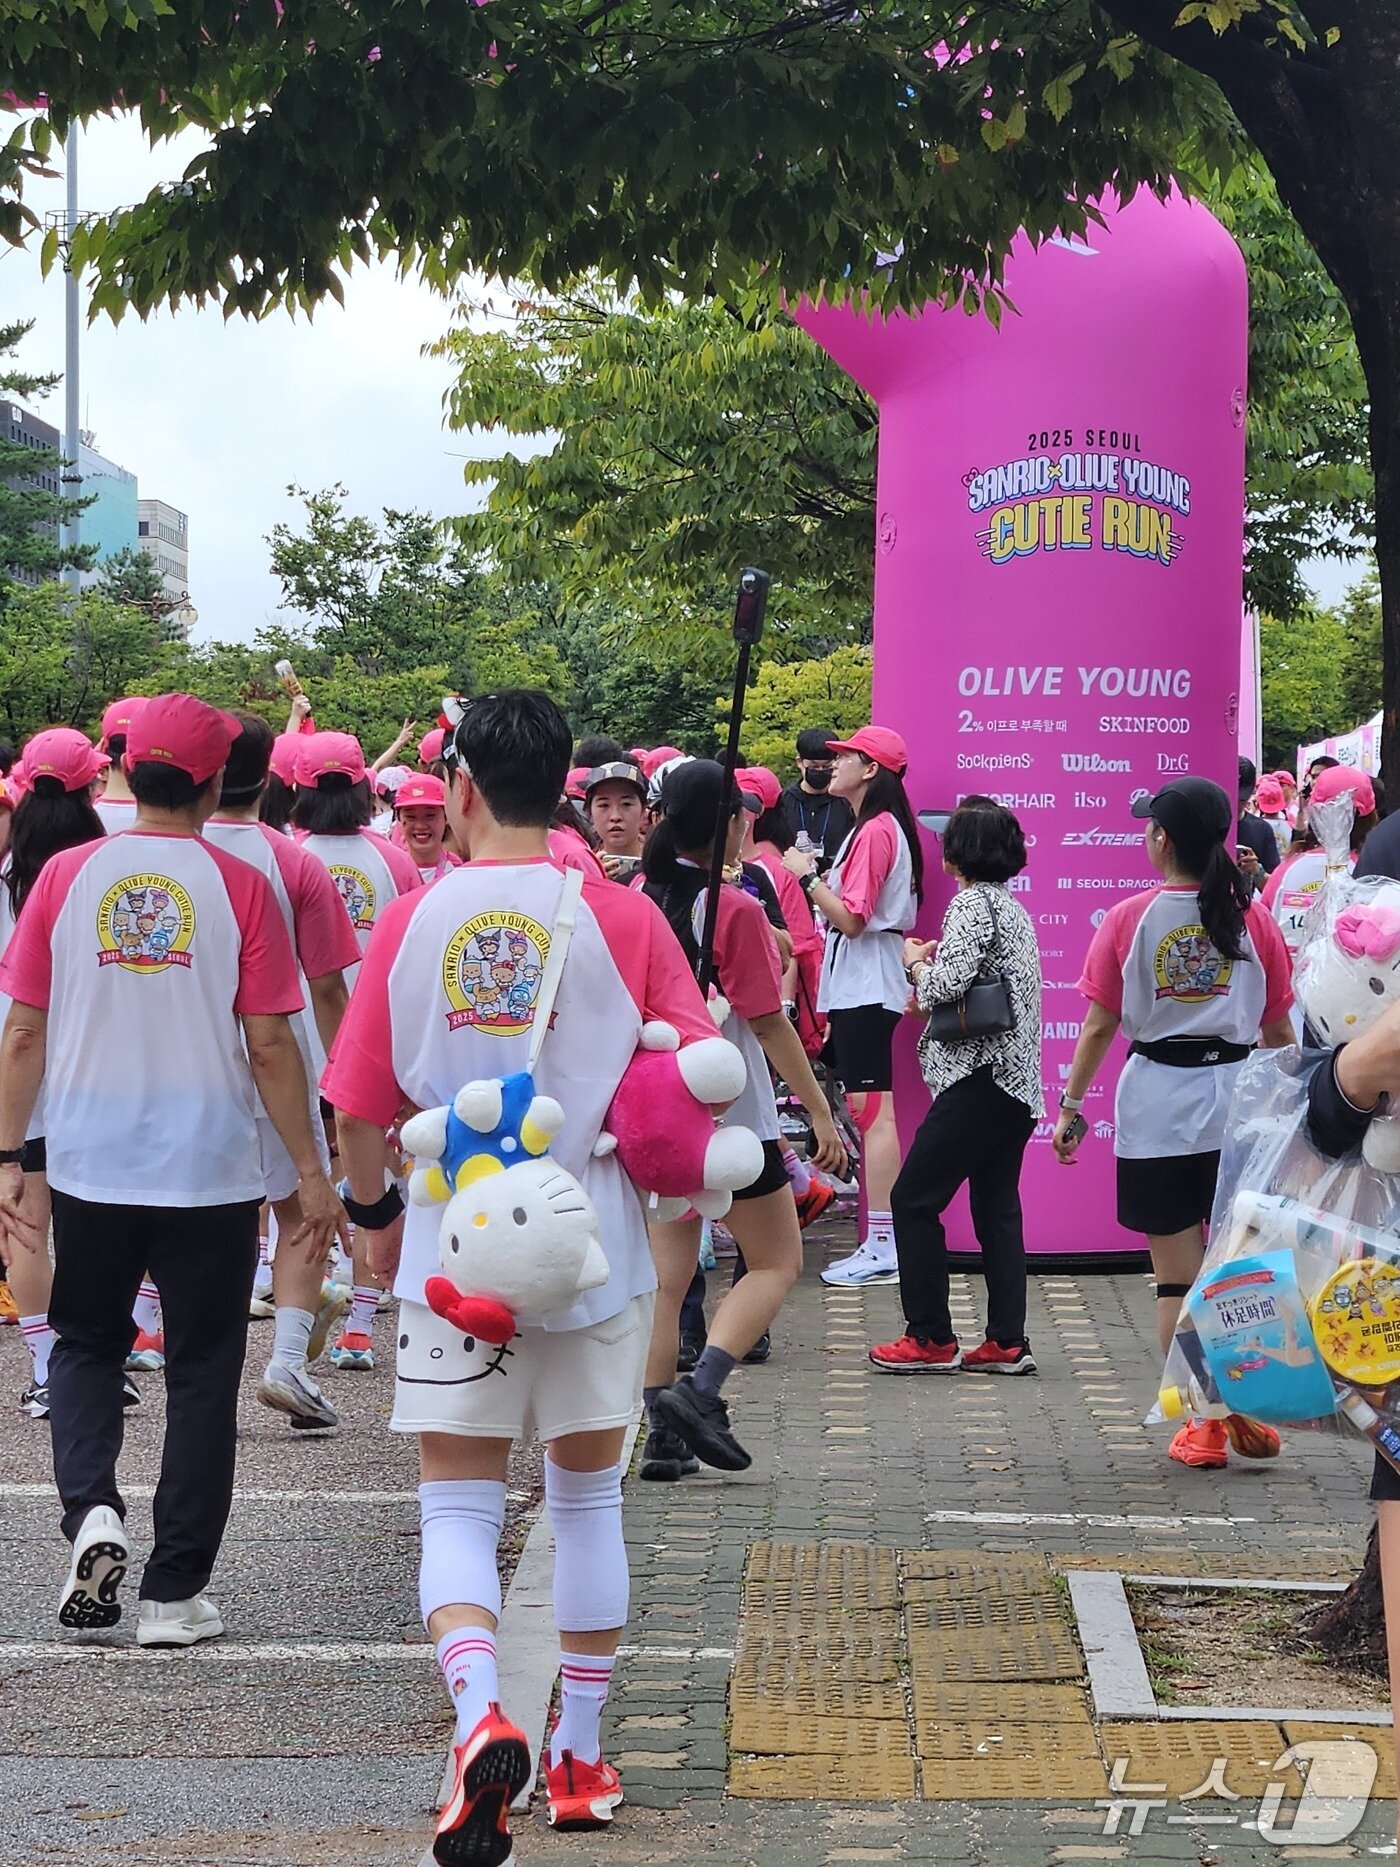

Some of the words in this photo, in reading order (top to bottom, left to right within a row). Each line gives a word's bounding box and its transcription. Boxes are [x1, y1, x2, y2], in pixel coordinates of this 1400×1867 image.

[1028, 429, 1074, 451] 2025
[1085, 430, 1142, 453] SEOUL
[968, 455, 1051, 513] SANRIO
[1059, 452, 1120, 492] OLIVE
[1122, 457, 1190, 516] YOUNG
[990, 496, 1093, 565] CUTIE
[1102, 496, 1172, 566] RUN
[958, 666, 1063, 696] OLIVE
[1078, 667, 1191, 698] YOUNG
[958, 709, 984, 732] 2%
[987, 720, 1019, 732] 이프로
[1099, 716, 1190, 733] SKINFOOD
[1061, 753, 1133, 772] Wilson
[1157, 753, 1189, 771] Dr.G
[1074, 792, 1107, 808] ilso
[1061, 827, 1146, 845] EXTREME
[1076, 879, 1115, 889] SEOUL
[100, 896, 114, 932] SANRIO
[147, 876, 177, 892] YOUNG
[174, 890, 191, 913] CUTIE
[1039, 914, 1069, 925] CITY
[168, 953, 189, 964] SEOUL
[446, 944, 461, 988] SANRIO
[500, 914, 535, 933] YOUNG
[452, 1010, 474, 1025] 2025
[1221, 1299, 1276, 1328] 休足時間
